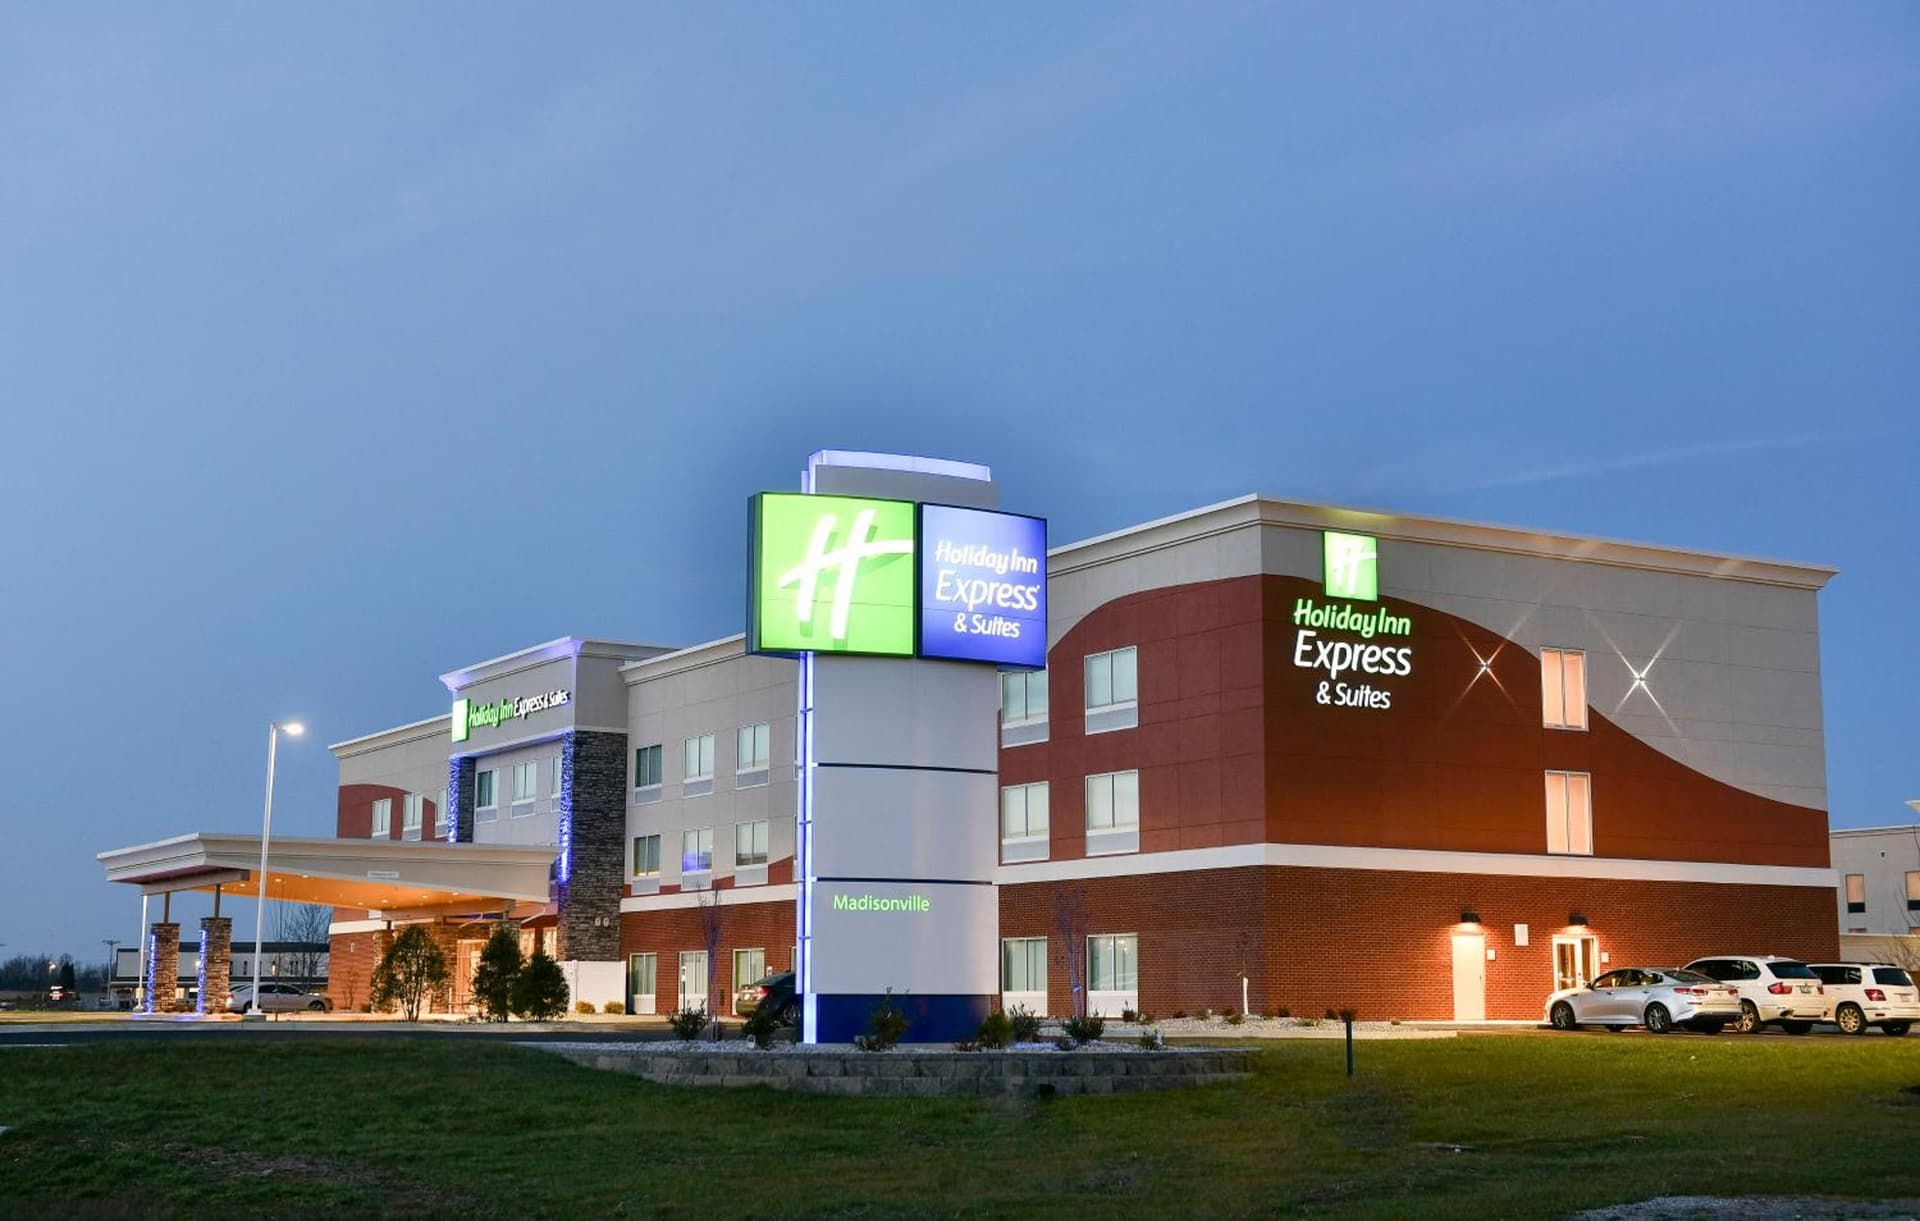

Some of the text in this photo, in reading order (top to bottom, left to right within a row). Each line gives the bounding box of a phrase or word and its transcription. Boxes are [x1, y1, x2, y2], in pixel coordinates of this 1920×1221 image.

[935, 540, 1037, 574] Holiday Inn
[936, 569, 1040, 611] Express
[954, 612, 1020, 638] & Suites
[1294, 599, 1411, 638] Holiday Inn
[1294, 629, 1412, 680] Express
[1316, 681, 1391, 709] & Suites
[469, 703, 500, 728] Holiday
[514, 696, 544, 720] Express
[833, 894, 930, 912] Madisonville
